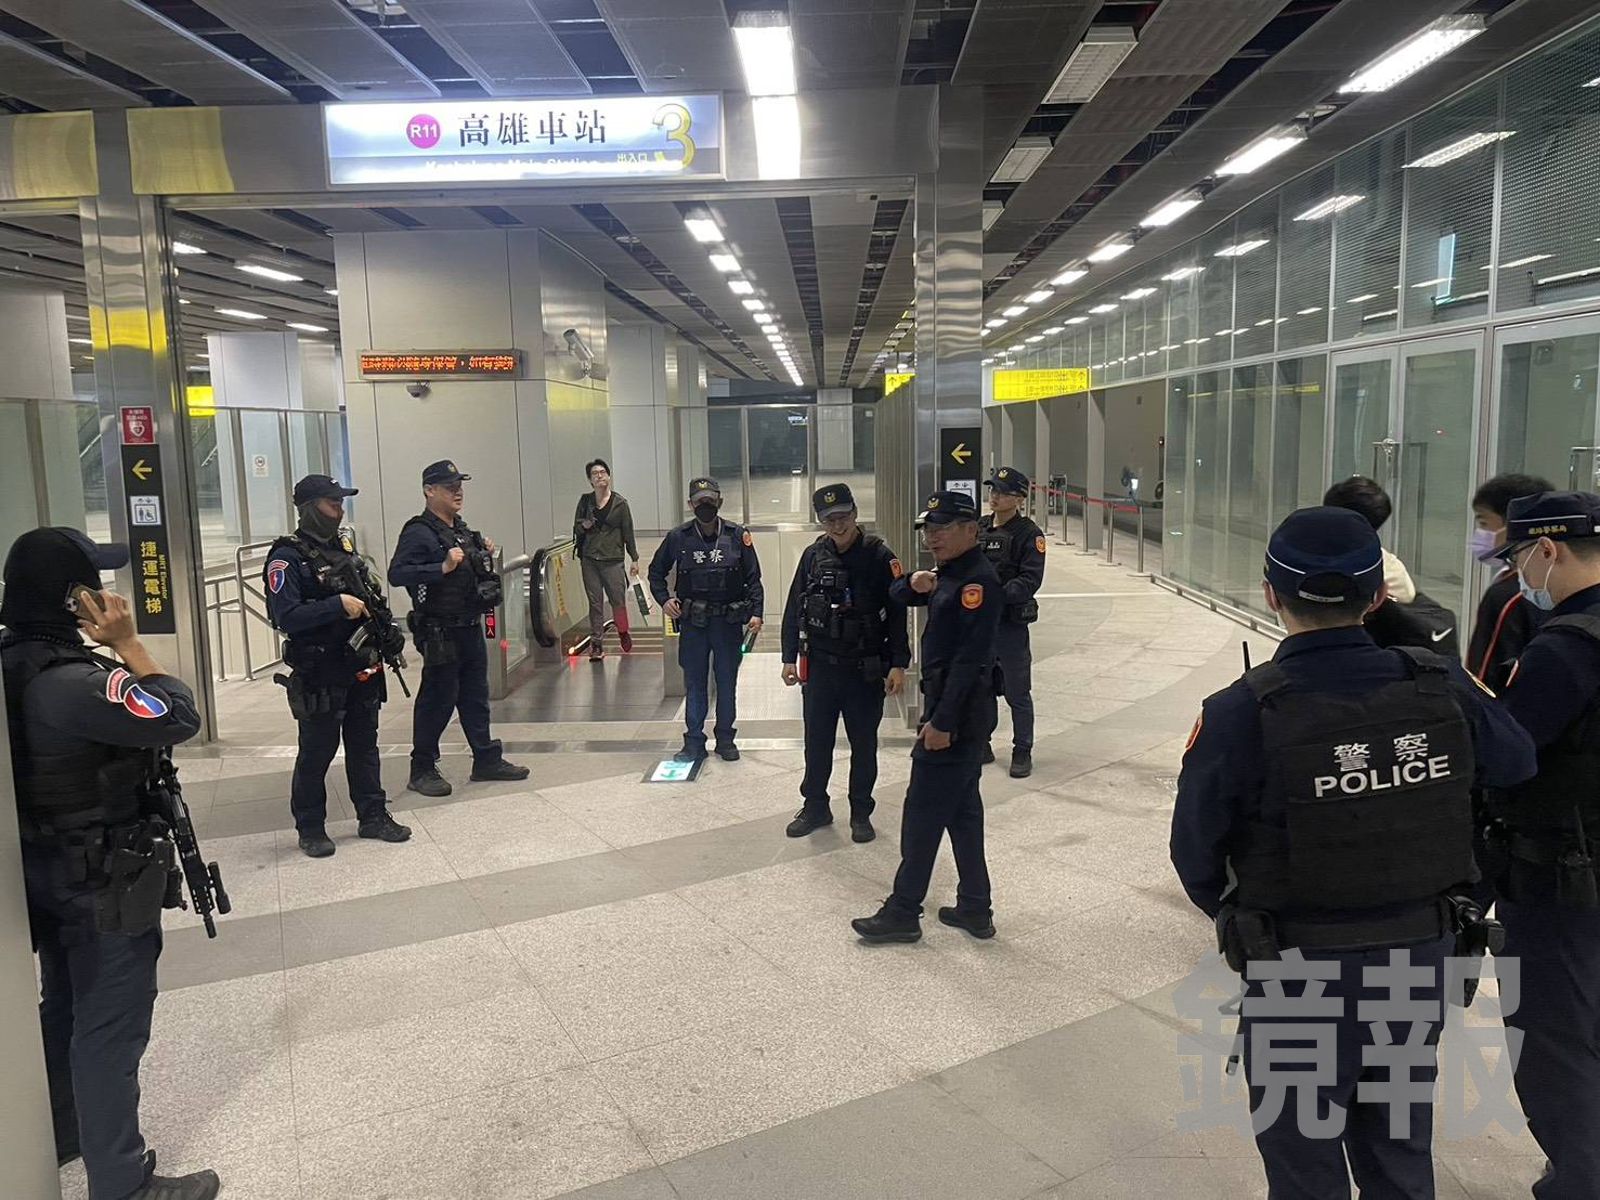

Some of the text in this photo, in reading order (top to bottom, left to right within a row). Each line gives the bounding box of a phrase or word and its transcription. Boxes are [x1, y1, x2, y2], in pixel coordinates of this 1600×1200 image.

[410, 124, 438, 138] R11
[458, 109, 606, 147] 高雄車站
[652, 103, 697, 168] 3
[693, 548, 724, 564] 警察
[140, 541, 162, 613] 捷運電梯
[1334, 733, 1429, 772] 警察
[1314, 755, 1451, 797] POLICE
